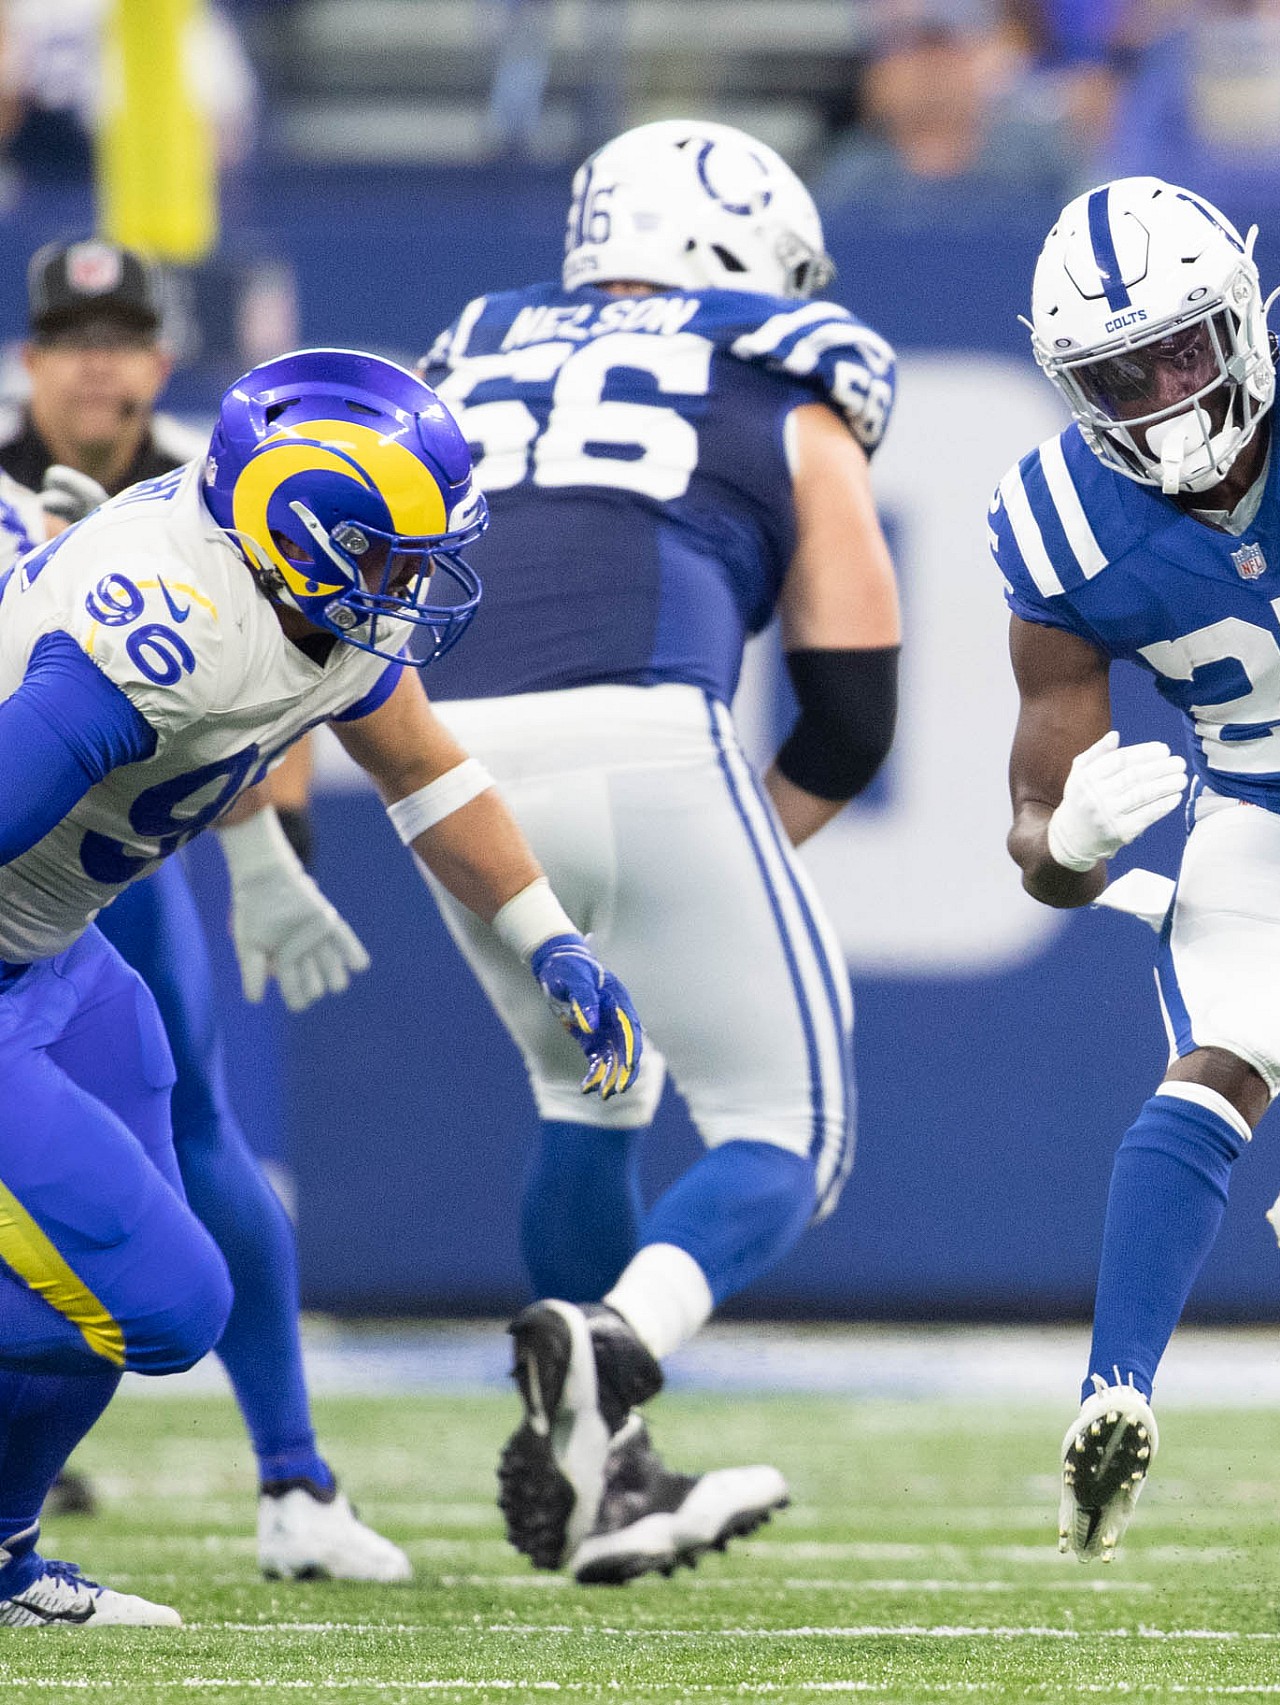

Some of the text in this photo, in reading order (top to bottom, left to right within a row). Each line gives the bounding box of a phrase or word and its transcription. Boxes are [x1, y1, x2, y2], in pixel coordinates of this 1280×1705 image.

[500, 296, 700, 351] NELSON
[1105, 309, 1147, 334] COLTS
[1241, 557, 1262, 575] NFL
[85, 572, 196, 687] 96
